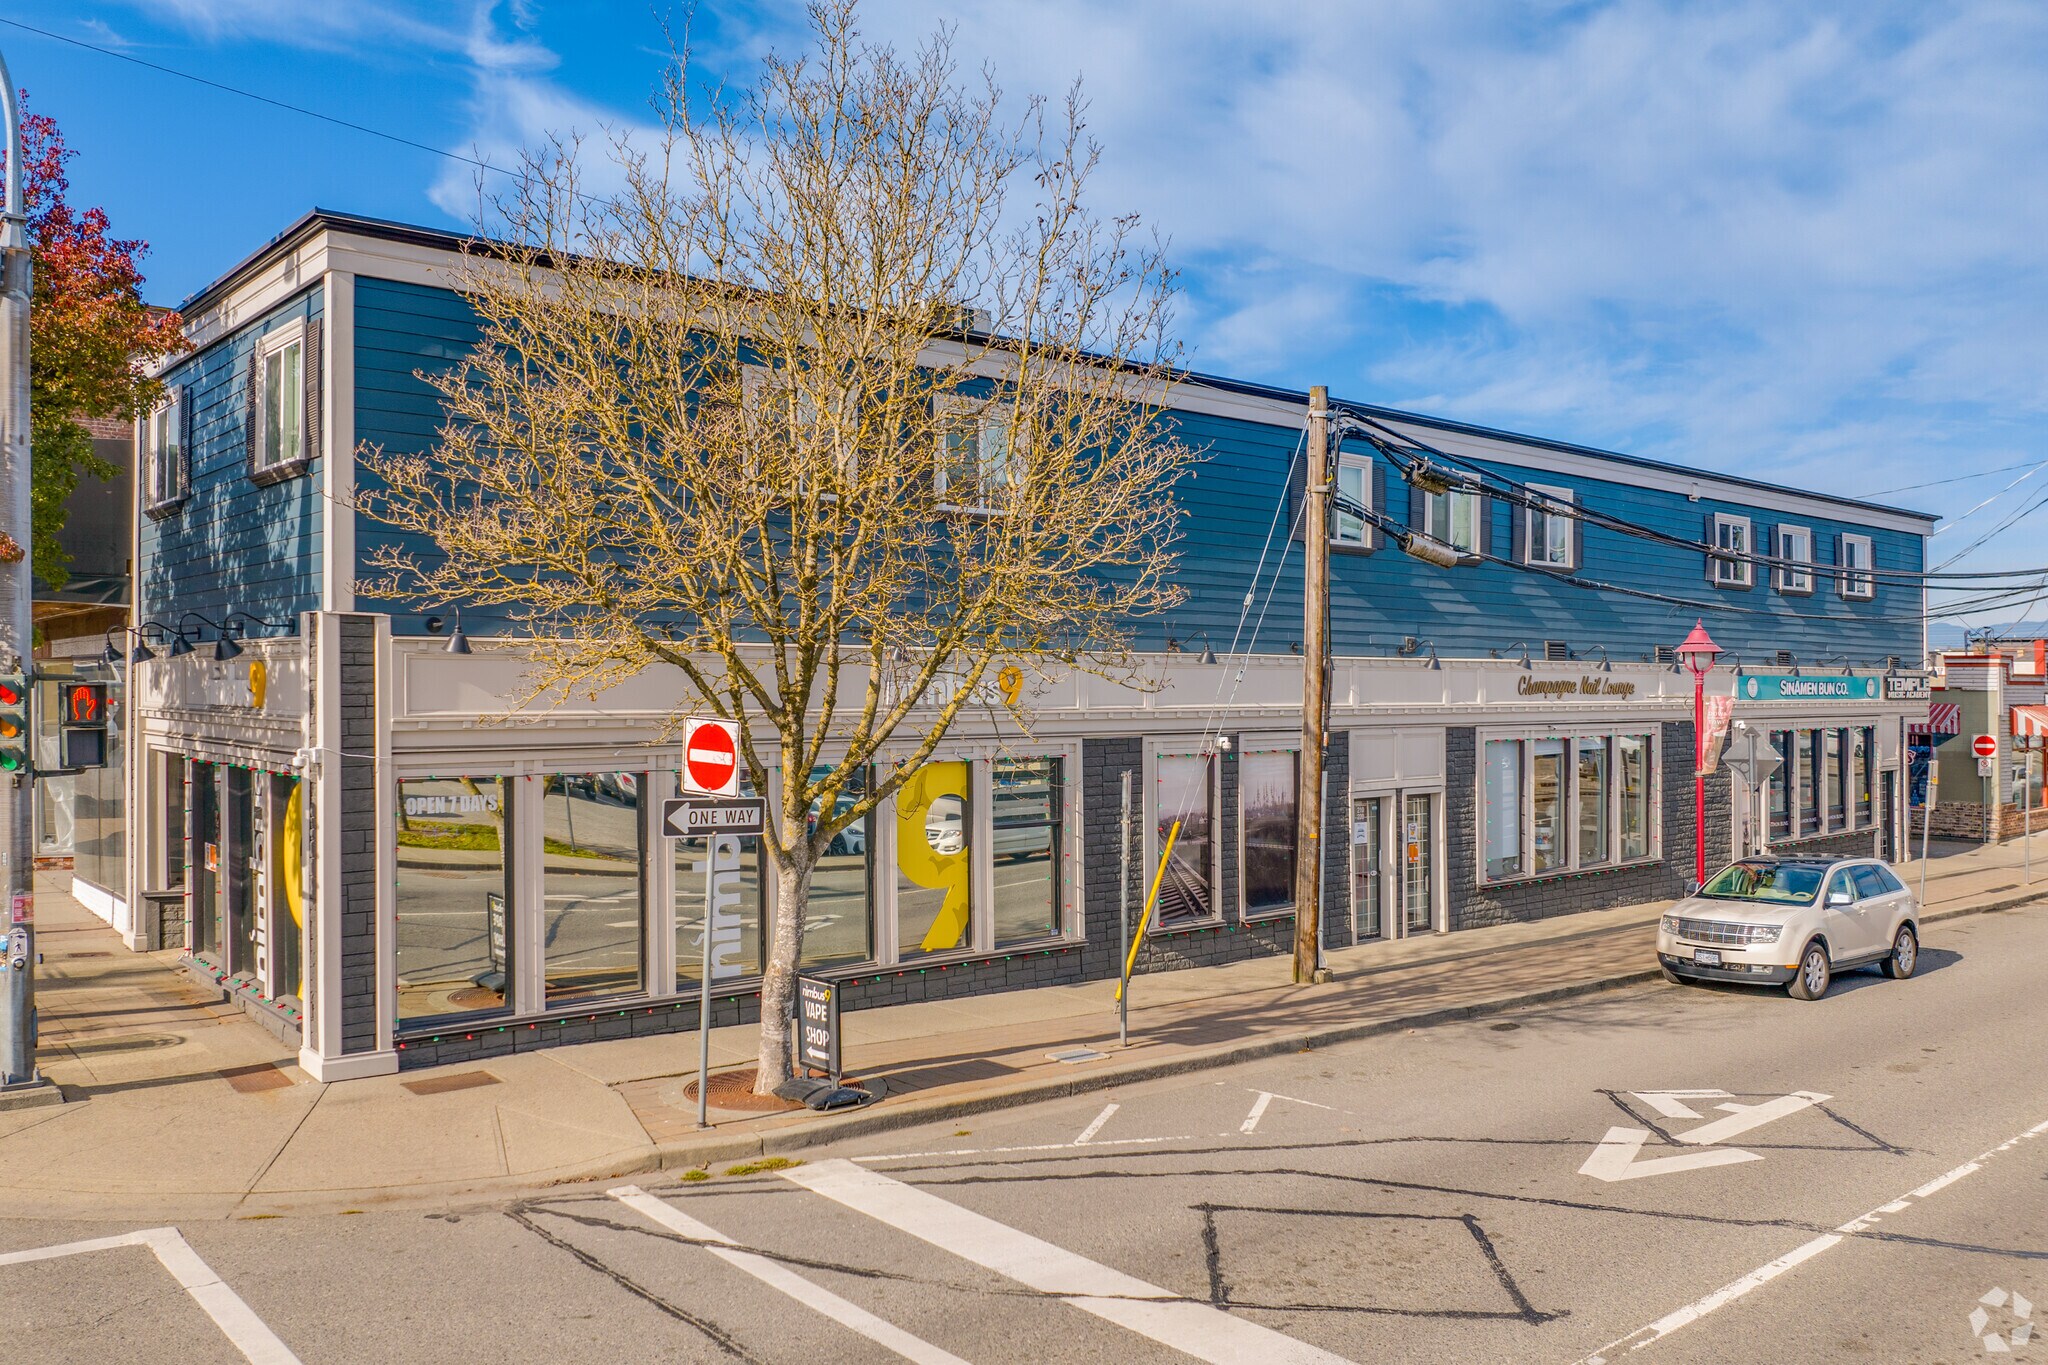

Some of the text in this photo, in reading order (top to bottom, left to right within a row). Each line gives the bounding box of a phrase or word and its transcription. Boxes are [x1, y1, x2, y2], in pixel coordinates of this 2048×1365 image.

[1518, 675, 1635, 700] Champagne Nail Lounge
[1819, 682, 1835, 696] BUN
[1887, 677, 1931, 691] TEMPLE
[1887, 691, 1906, 699] MUSIC
[405, 794, 498, 816] OPEN 7 DAYS
[689, 809, 754, 825] ONE WAY
[805, 1000, 828, 1022] VAPE
[806, 1025, 830, 1046] SHOP
